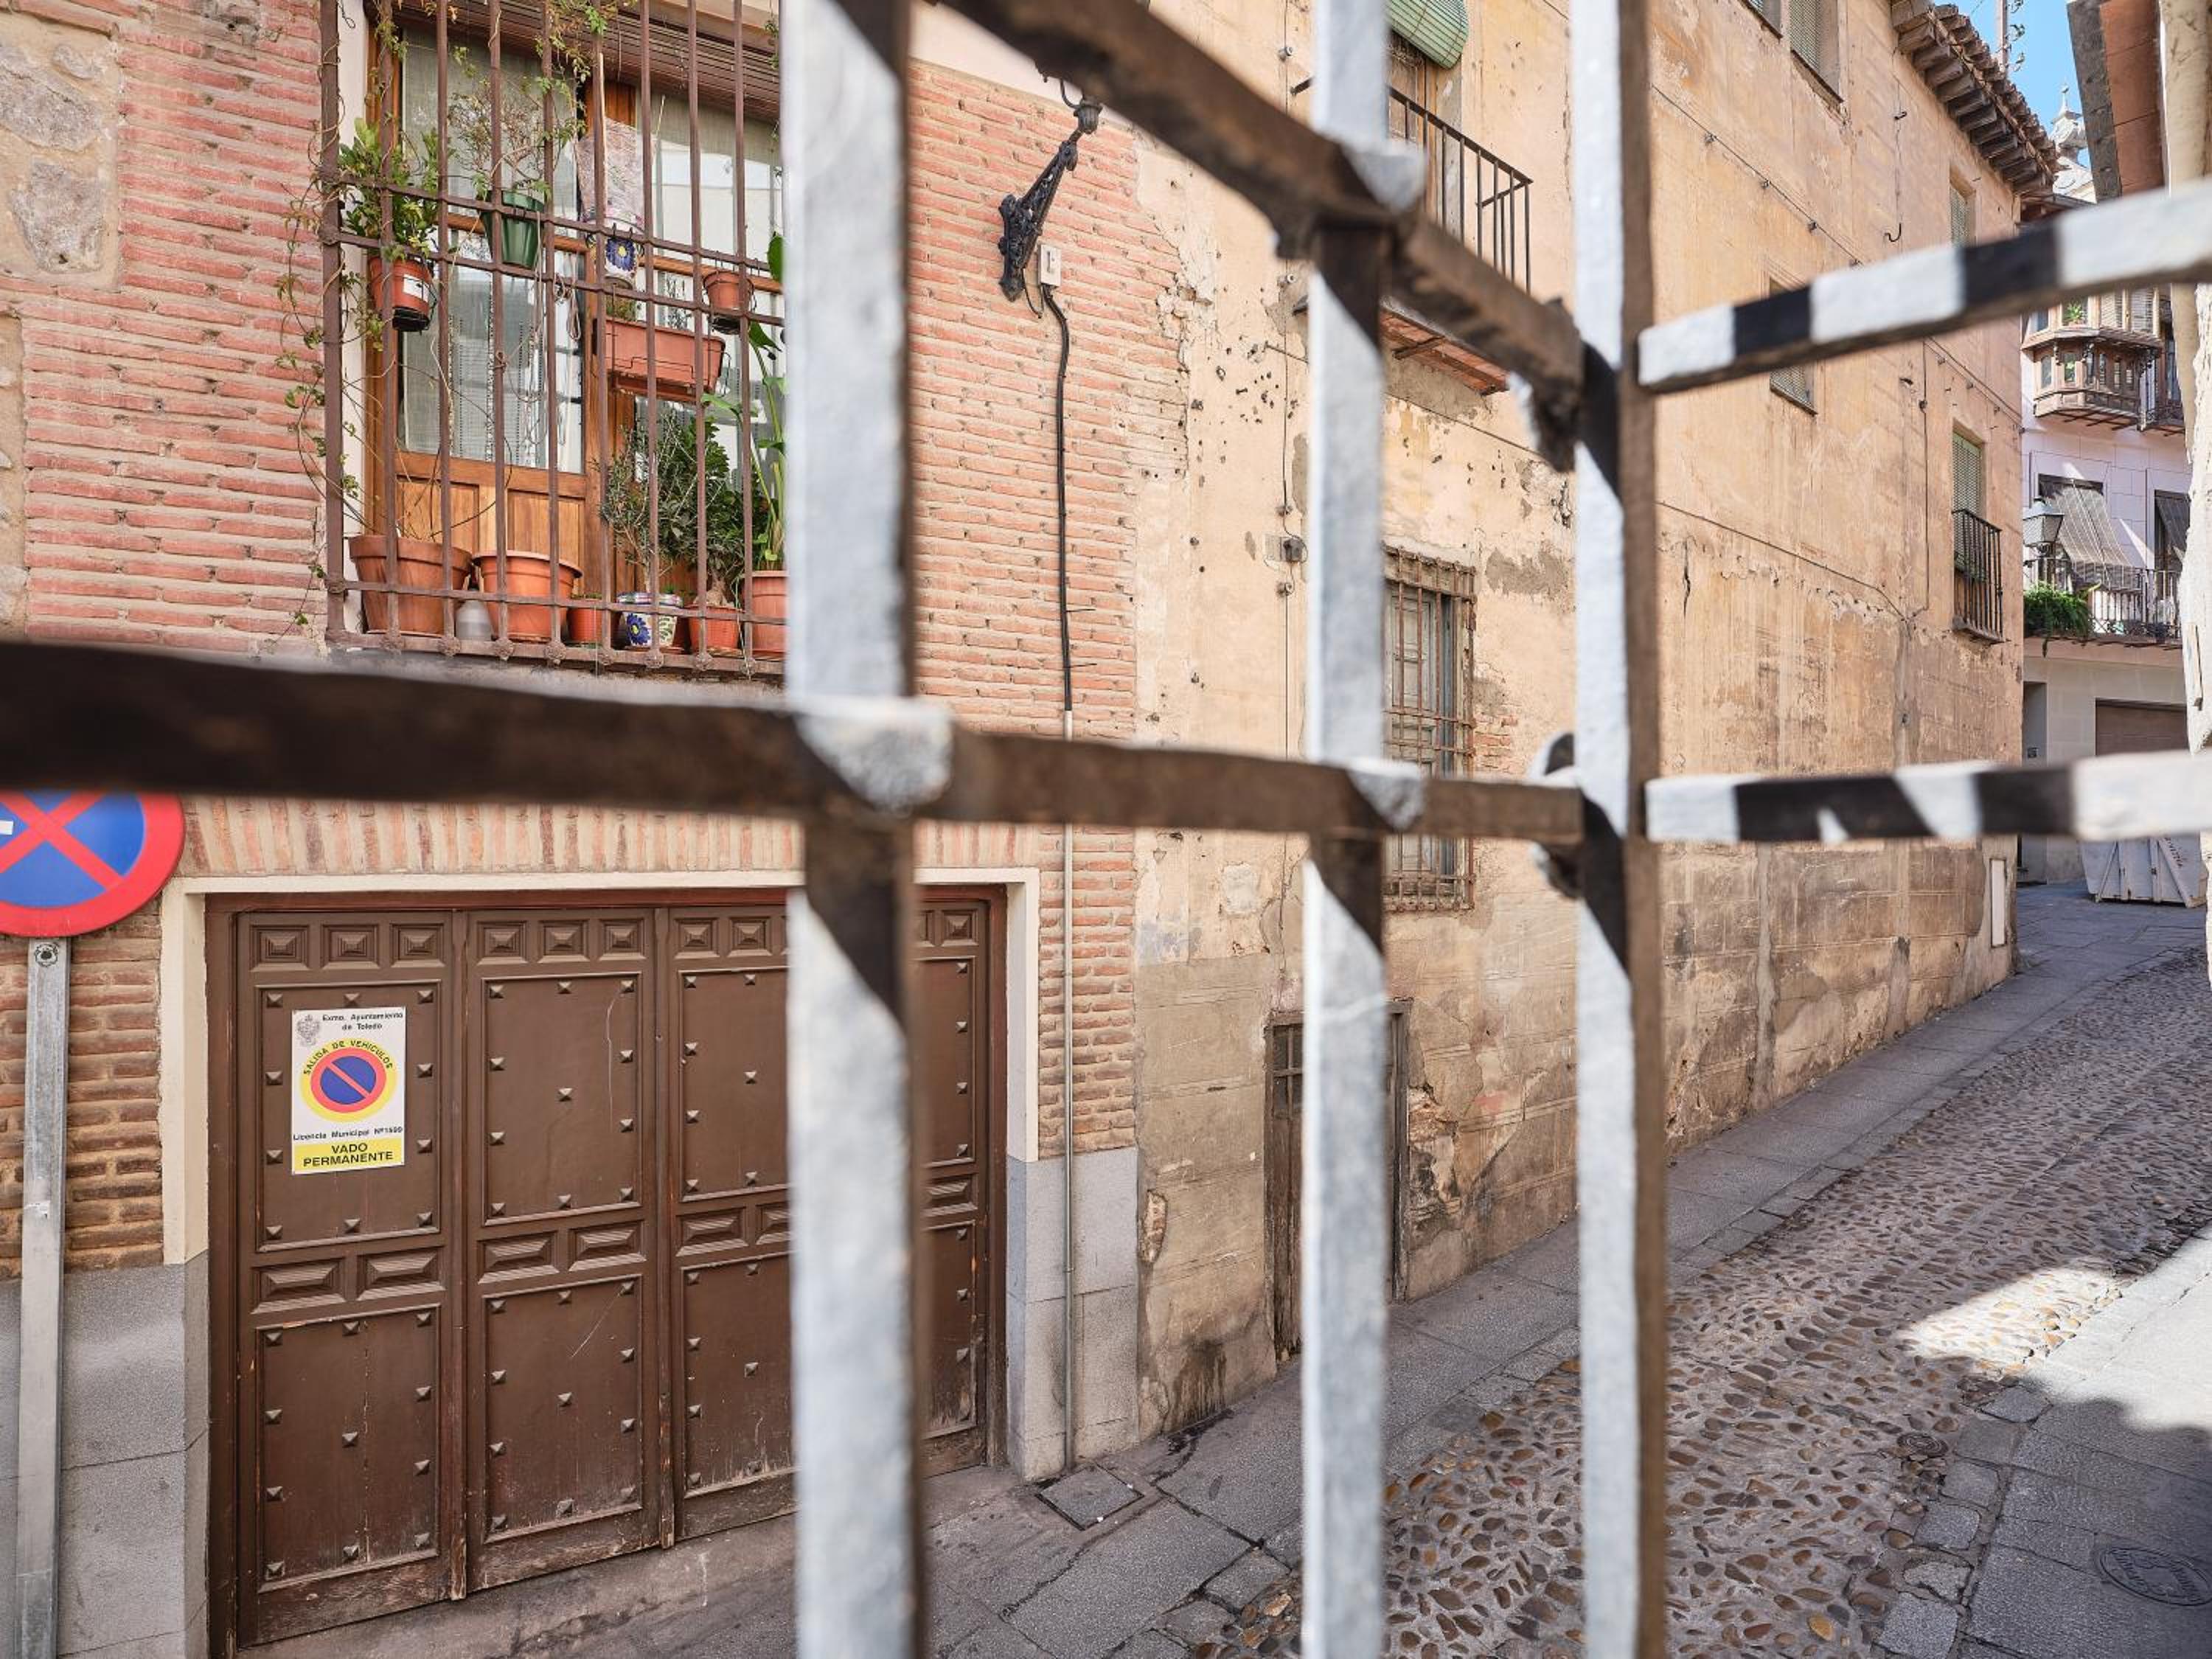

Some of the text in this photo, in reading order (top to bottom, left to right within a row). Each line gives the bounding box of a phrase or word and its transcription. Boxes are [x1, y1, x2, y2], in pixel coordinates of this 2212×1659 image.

[350, 1012, 403, 1021] Ayuntamiento
[303, 1040, 393, 1074] SALIDA DE VEHICULOS
[293, 1132, 327, 1141] Licencia
[331, 1129, 369, 1138] Municipal
[331, 1143, 368, 1154] VADO
[303, 1151, 393, 1166] PERMANENTE
